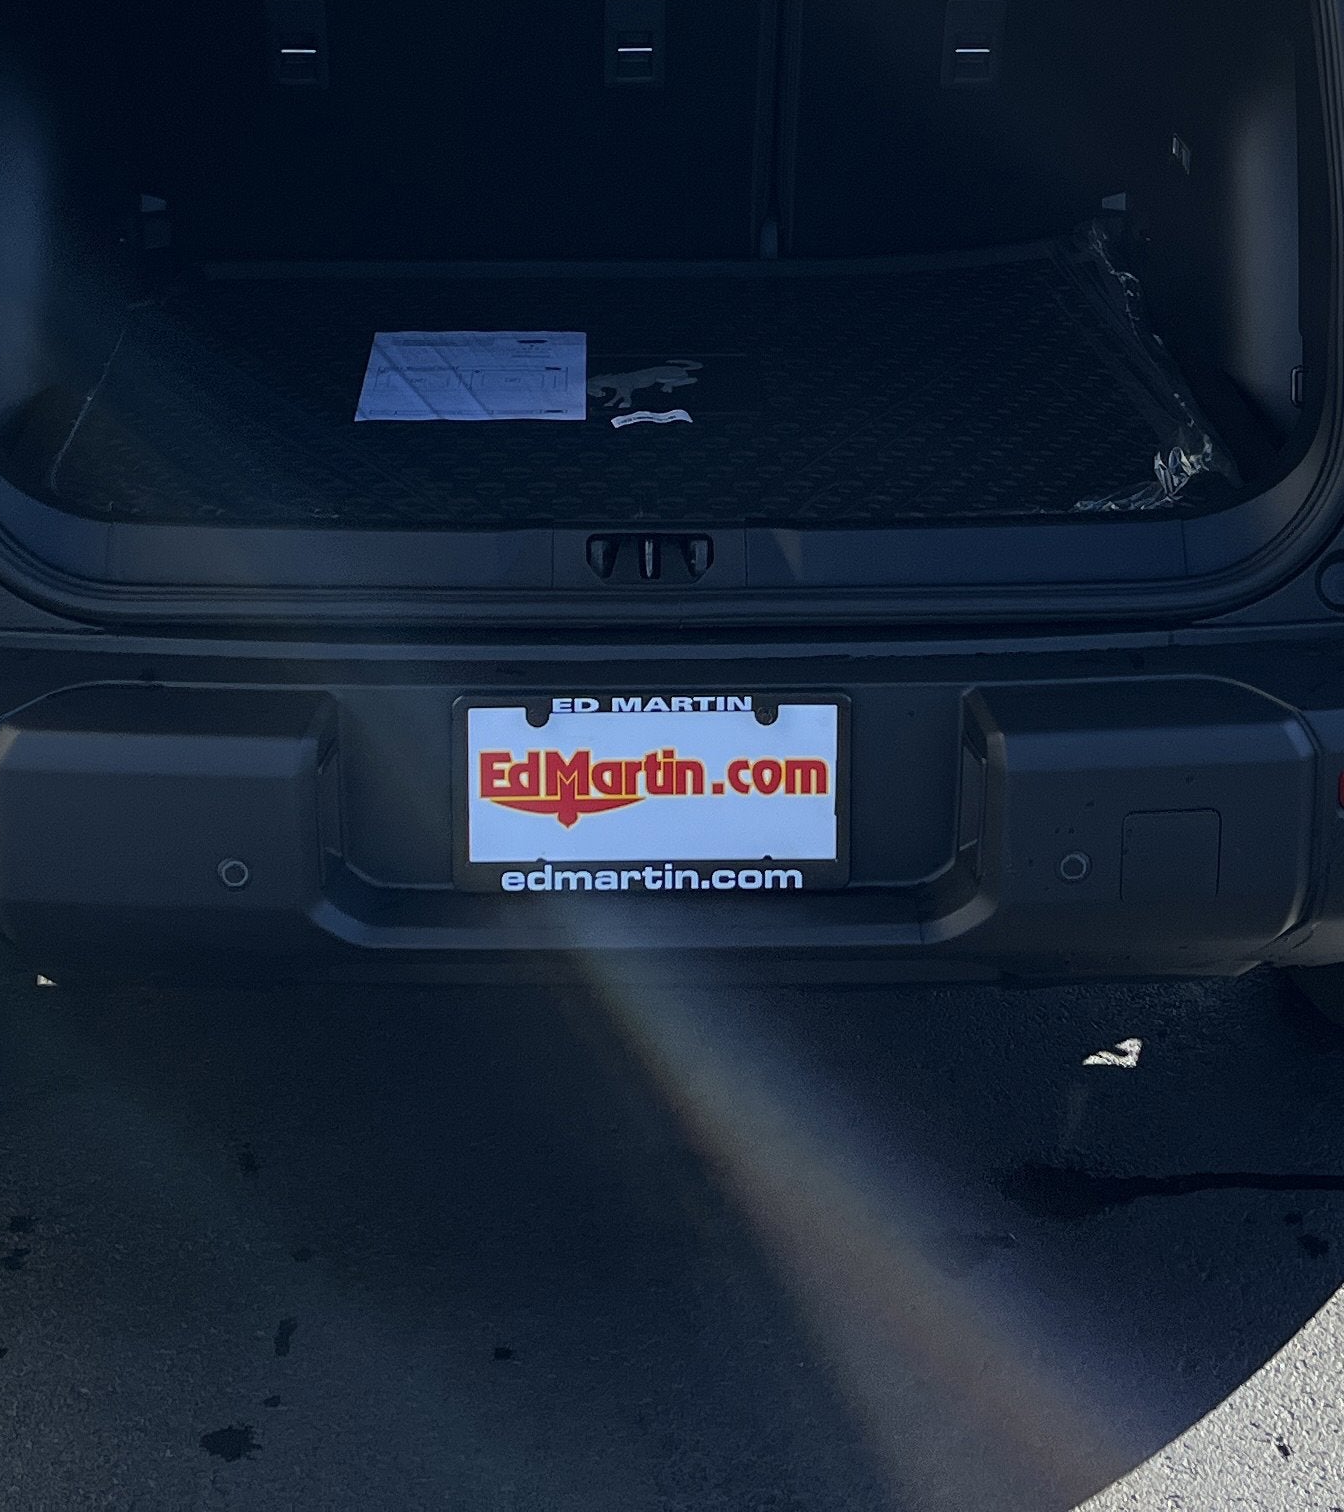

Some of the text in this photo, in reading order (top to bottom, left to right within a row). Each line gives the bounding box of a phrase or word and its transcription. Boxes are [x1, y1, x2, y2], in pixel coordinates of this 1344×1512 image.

[552, 696, 753, 713] ED MARTIN
[479, 748, 829, 799] EdMartin.com
[501, 864, 803, 892] edmartin.com
